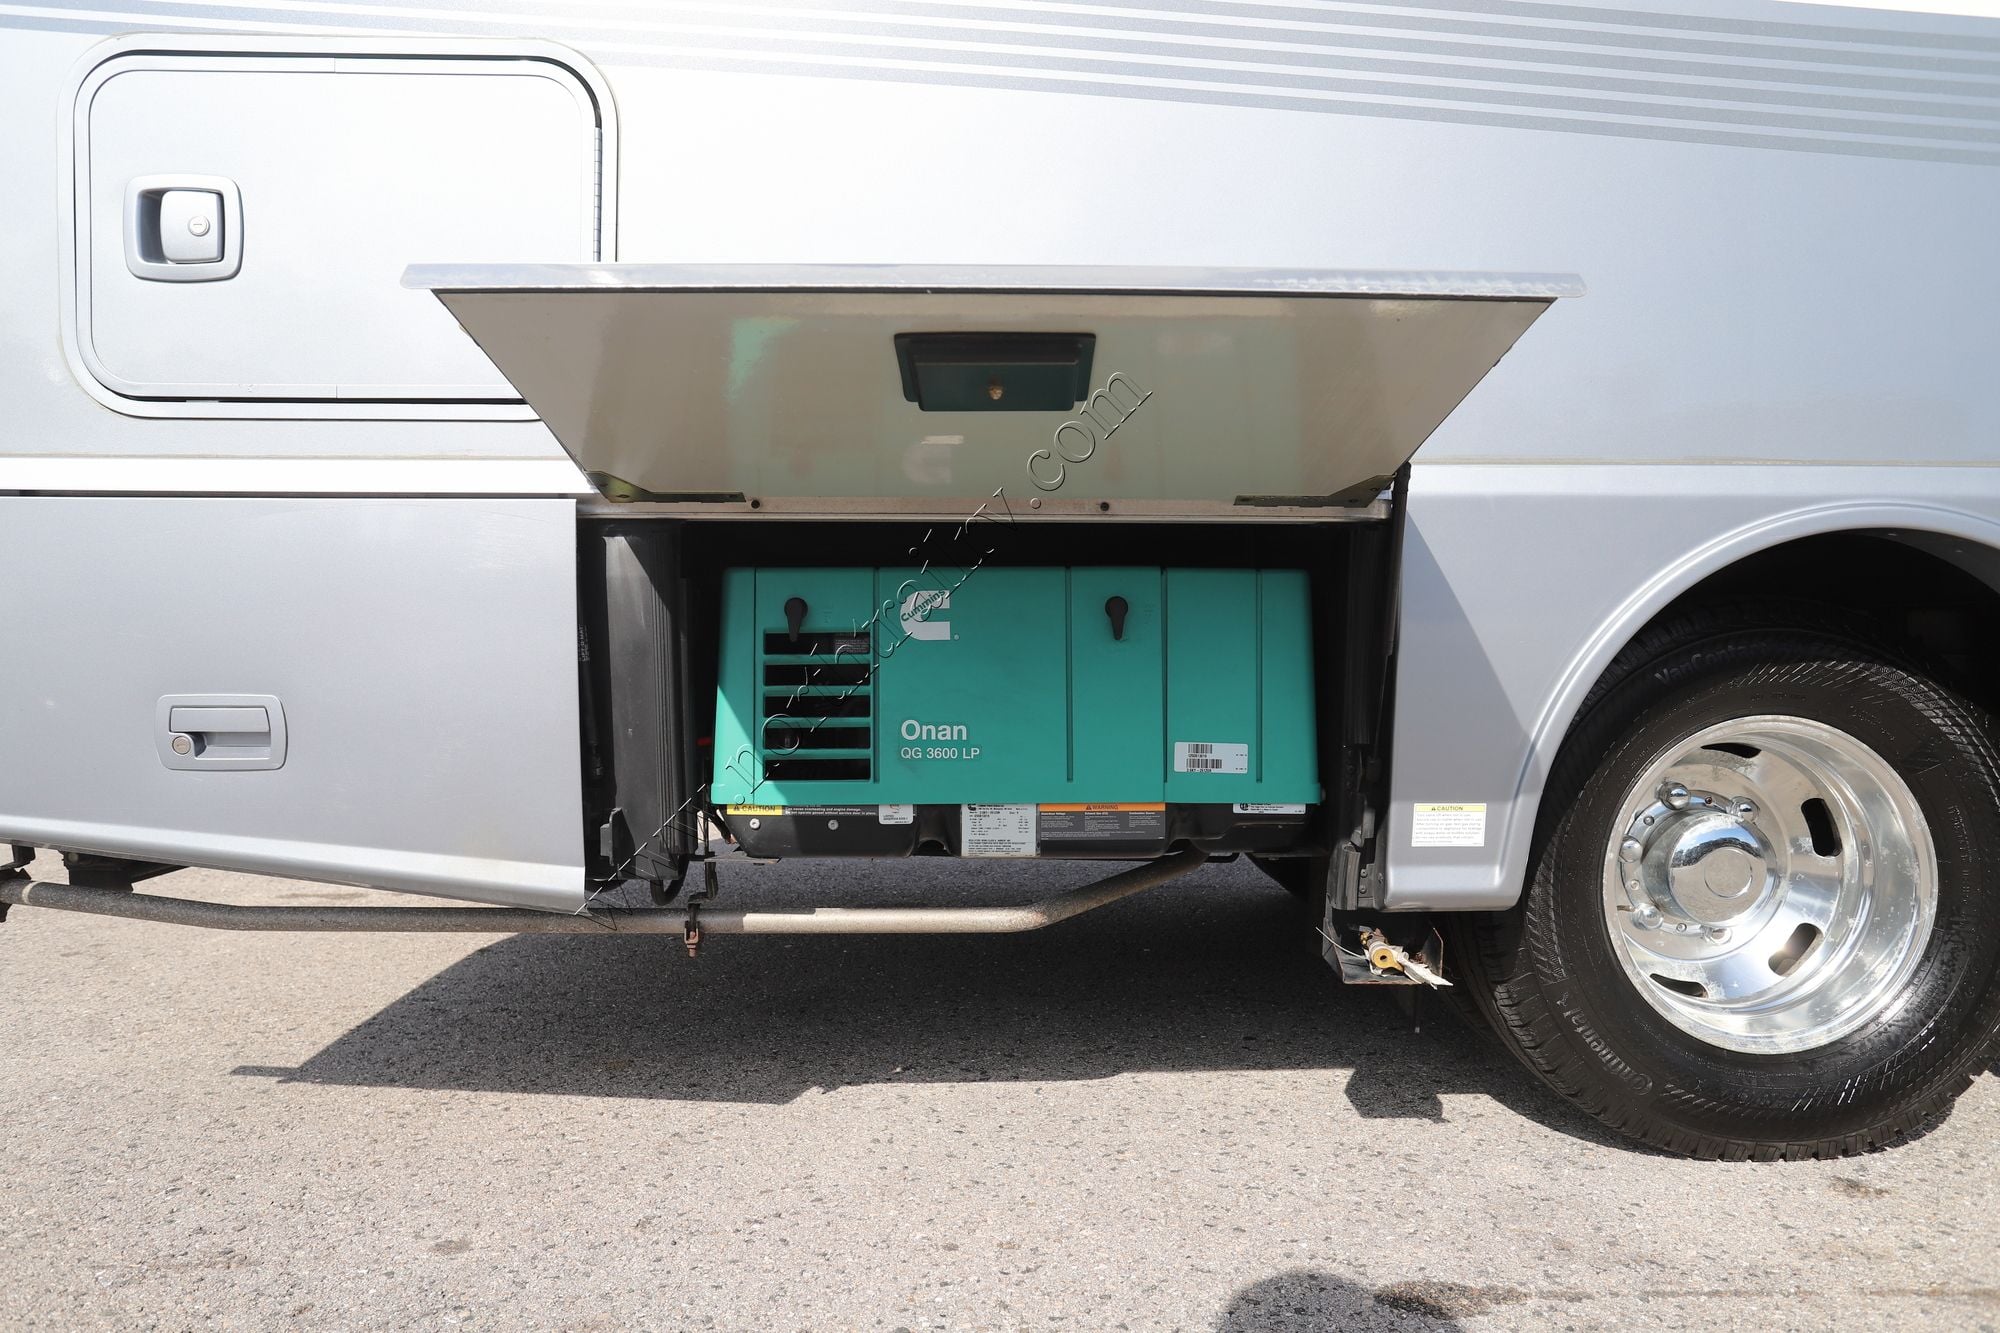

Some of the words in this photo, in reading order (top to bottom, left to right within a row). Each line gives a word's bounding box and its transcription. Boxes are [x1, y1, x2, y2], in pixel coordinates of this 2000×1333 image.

[900, 590, 945, 622] Cummins
[901, 719, 967, 740] Onan
[900, 747, 922, 759] QG
[926, 747, 958, 759] 3600
[962, 747, 980, 759] LP
